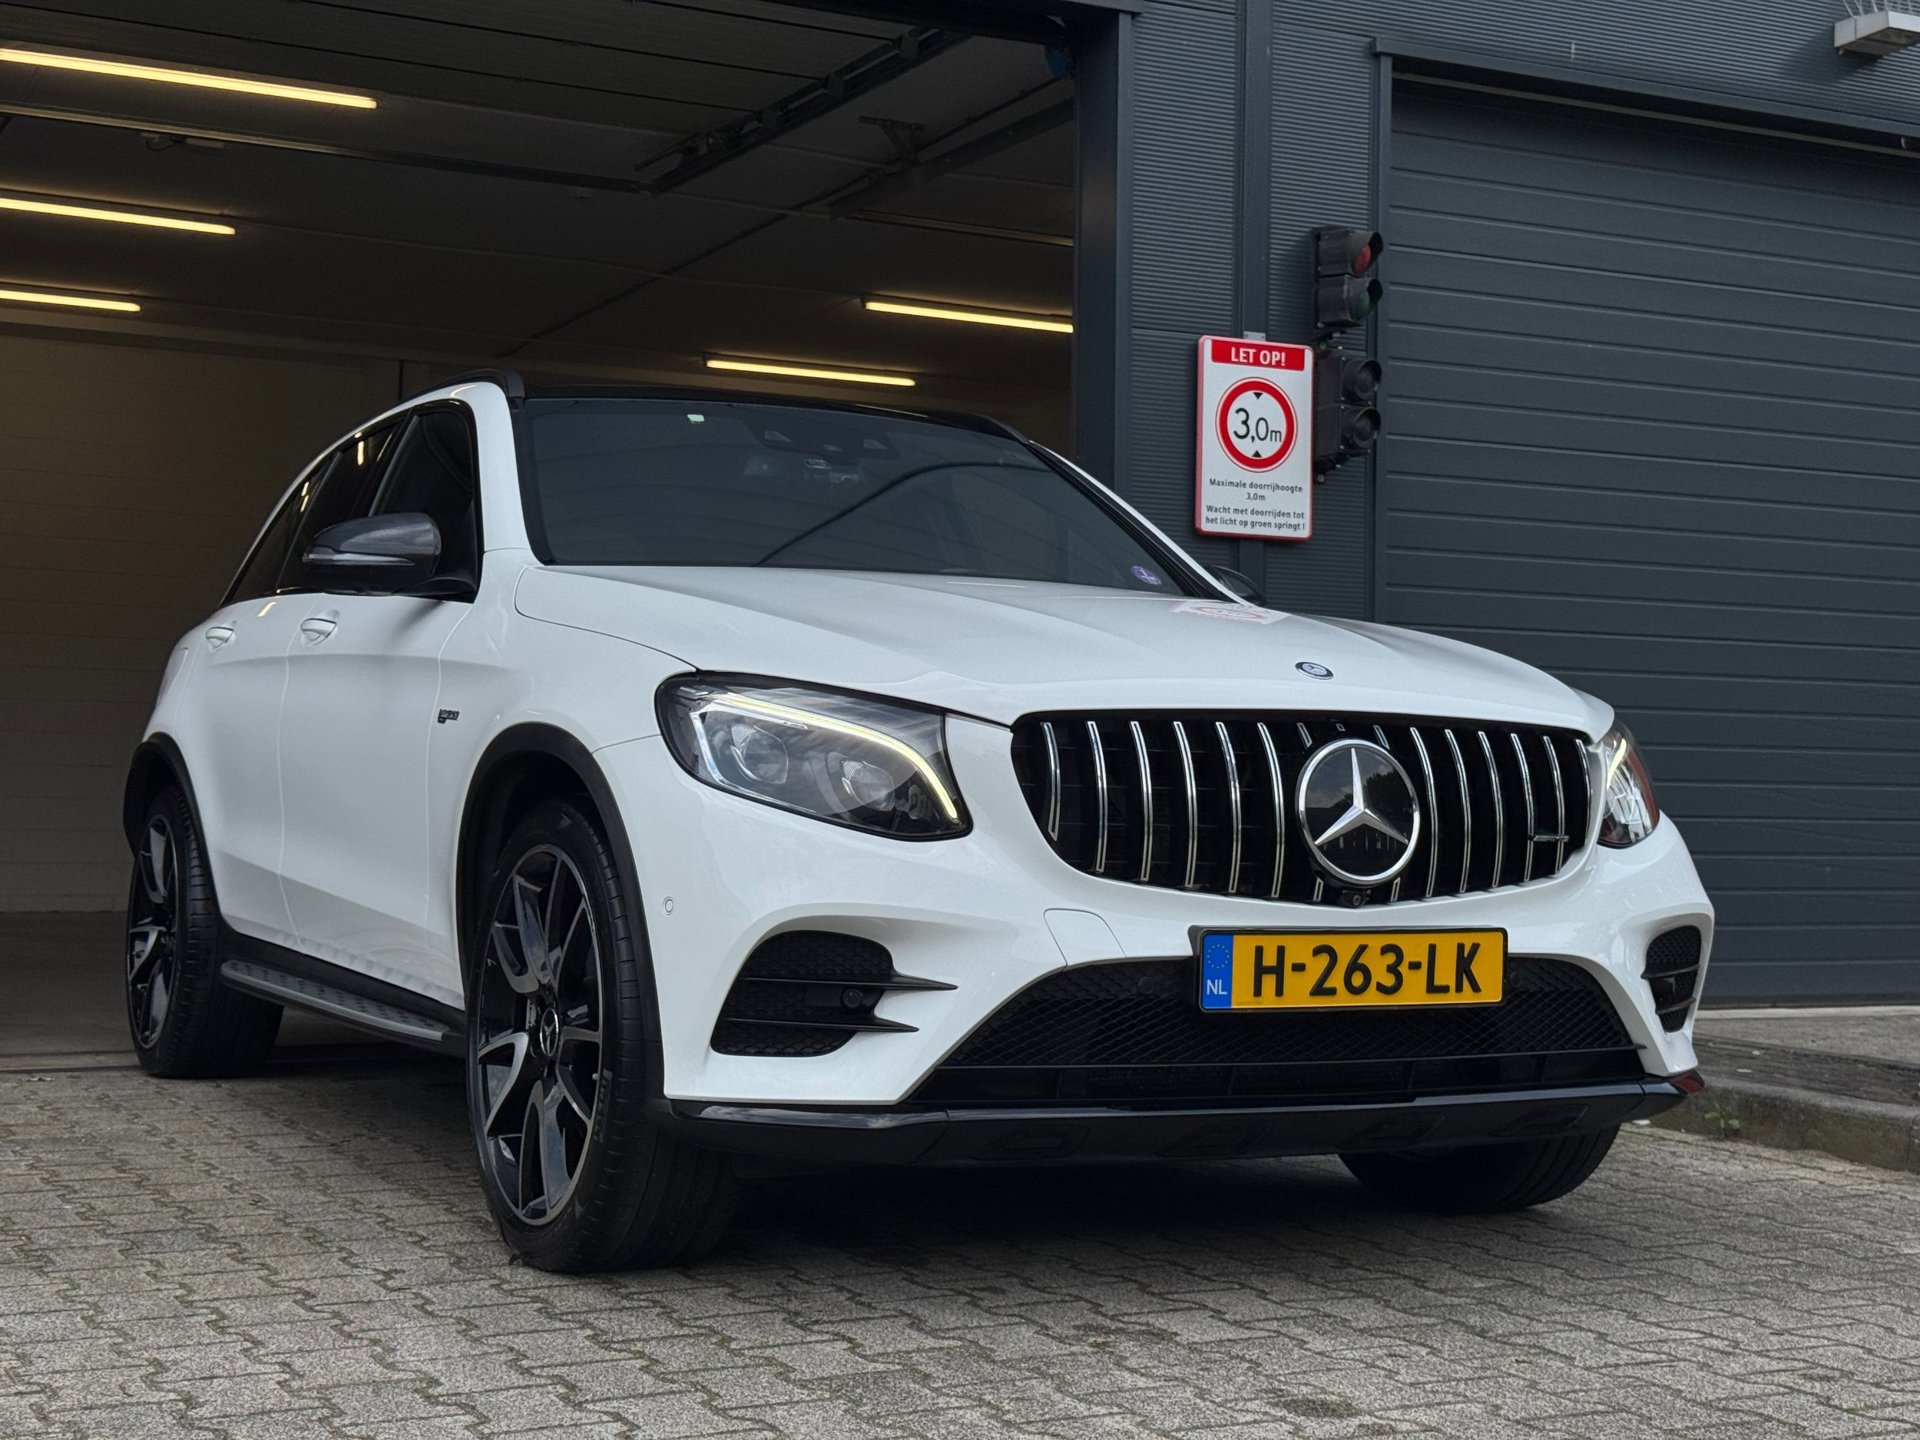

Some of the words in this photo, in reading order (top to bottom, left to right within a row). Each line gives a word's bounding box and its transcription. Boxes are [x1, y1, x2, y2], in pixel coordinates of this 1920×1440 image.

[1231, 346, 1257, 363] LET
[1260, 350, 1286, 367] OP!
[1233, 407, 1282, 443] 3,0m
[1209, 478, 1247, 489] Maximale
[1248, 481, 1303, 494] doorrijhoogte
[1206, 505, 1231, 514] Wacht
[1250, 508, 1291, 519] doorrijden
[1293, 511, 1305, 519] tot
[1205, 516, 1218, 524] het
[1220, 516, 1237, 525] licht
[1238, 519, 1249, 528] op
[1250, 520, 1272, 528] groen
[1273, 521, 1301, 531] springt
[1253, 942, 1482, 998] H-263-LK
[1206, 978, 1228, 996] NL
